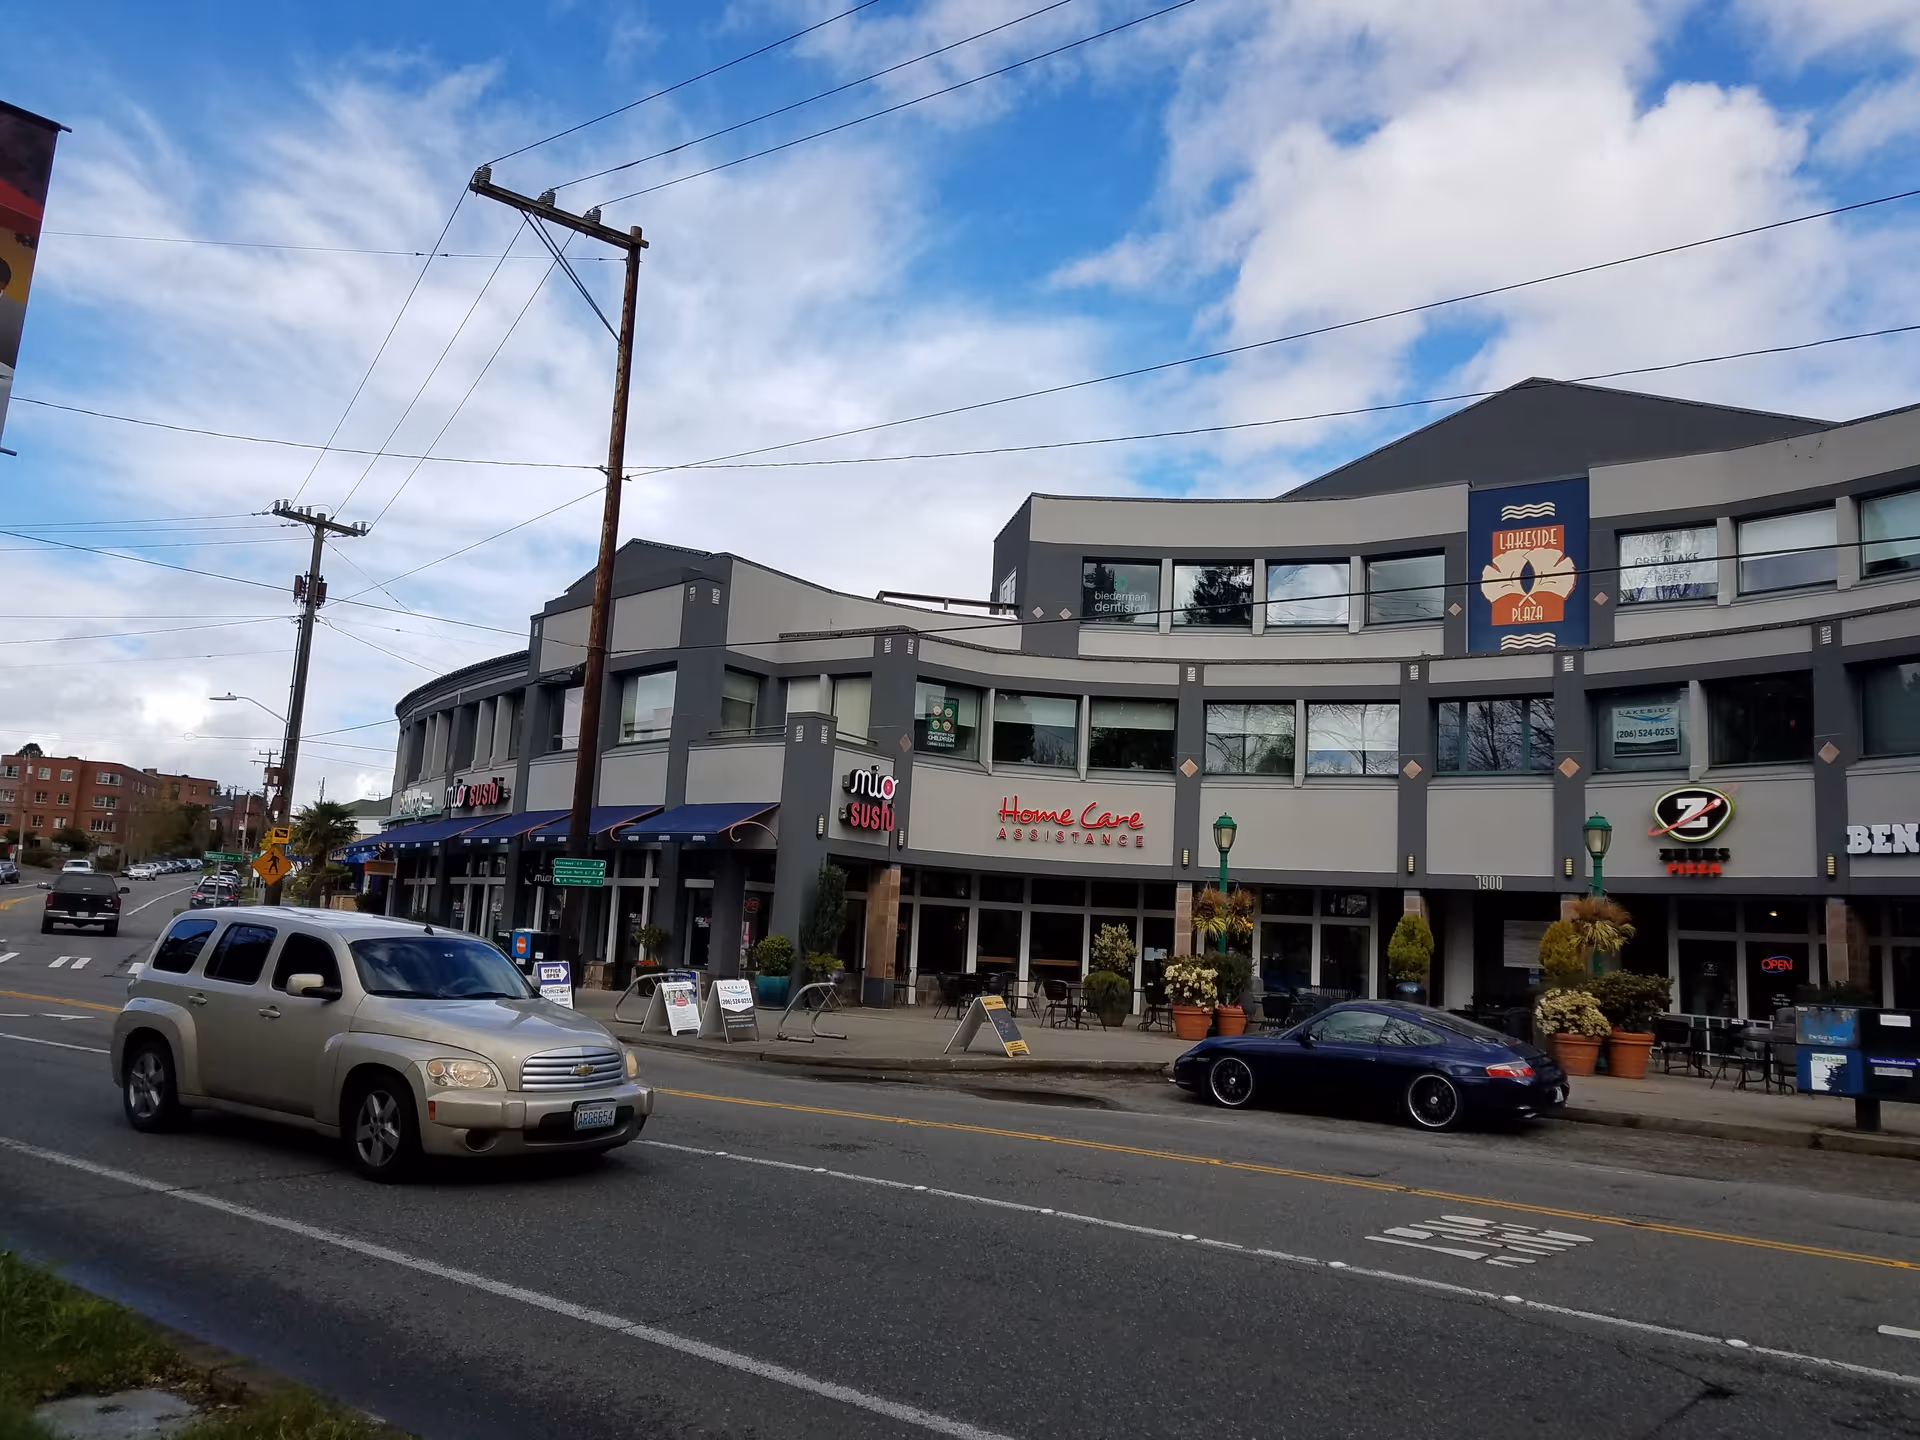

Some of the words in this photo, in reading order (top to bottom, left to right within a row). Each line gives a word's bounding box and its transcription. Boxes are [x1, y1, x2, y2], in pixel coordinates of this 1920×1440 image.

[1500, 528, 1557, 550] LAKESIDE
[1094, 590, 1147, 602] biederman
[1511, 605, 1544, 622] PLAZA
[1618, 707, 1673, 716] LAKESIDE
[927, 735, 955, 743] CHILDREN
[1616, 729, 1637, 740] (206)
[1638, 727, 1676, 738] 524-0255
[850, 765, 900, 800] mio
[442, 782, 468, 810] mio
[469, 778, 502, 807] sushi
[850, 801, 896, 832] sushi
[998, 795, 1075, 825] Home
[1080, 801, 1145, 829] Care
[1677, 797, 1708, 829] Z
[996, 826, 1145, 848] ASSISTANCE
[1666, 862, 1723, 875] PIZZA
[534, 873, 553, 882] mio
[1761, 958, 1793, 971] OPEN
